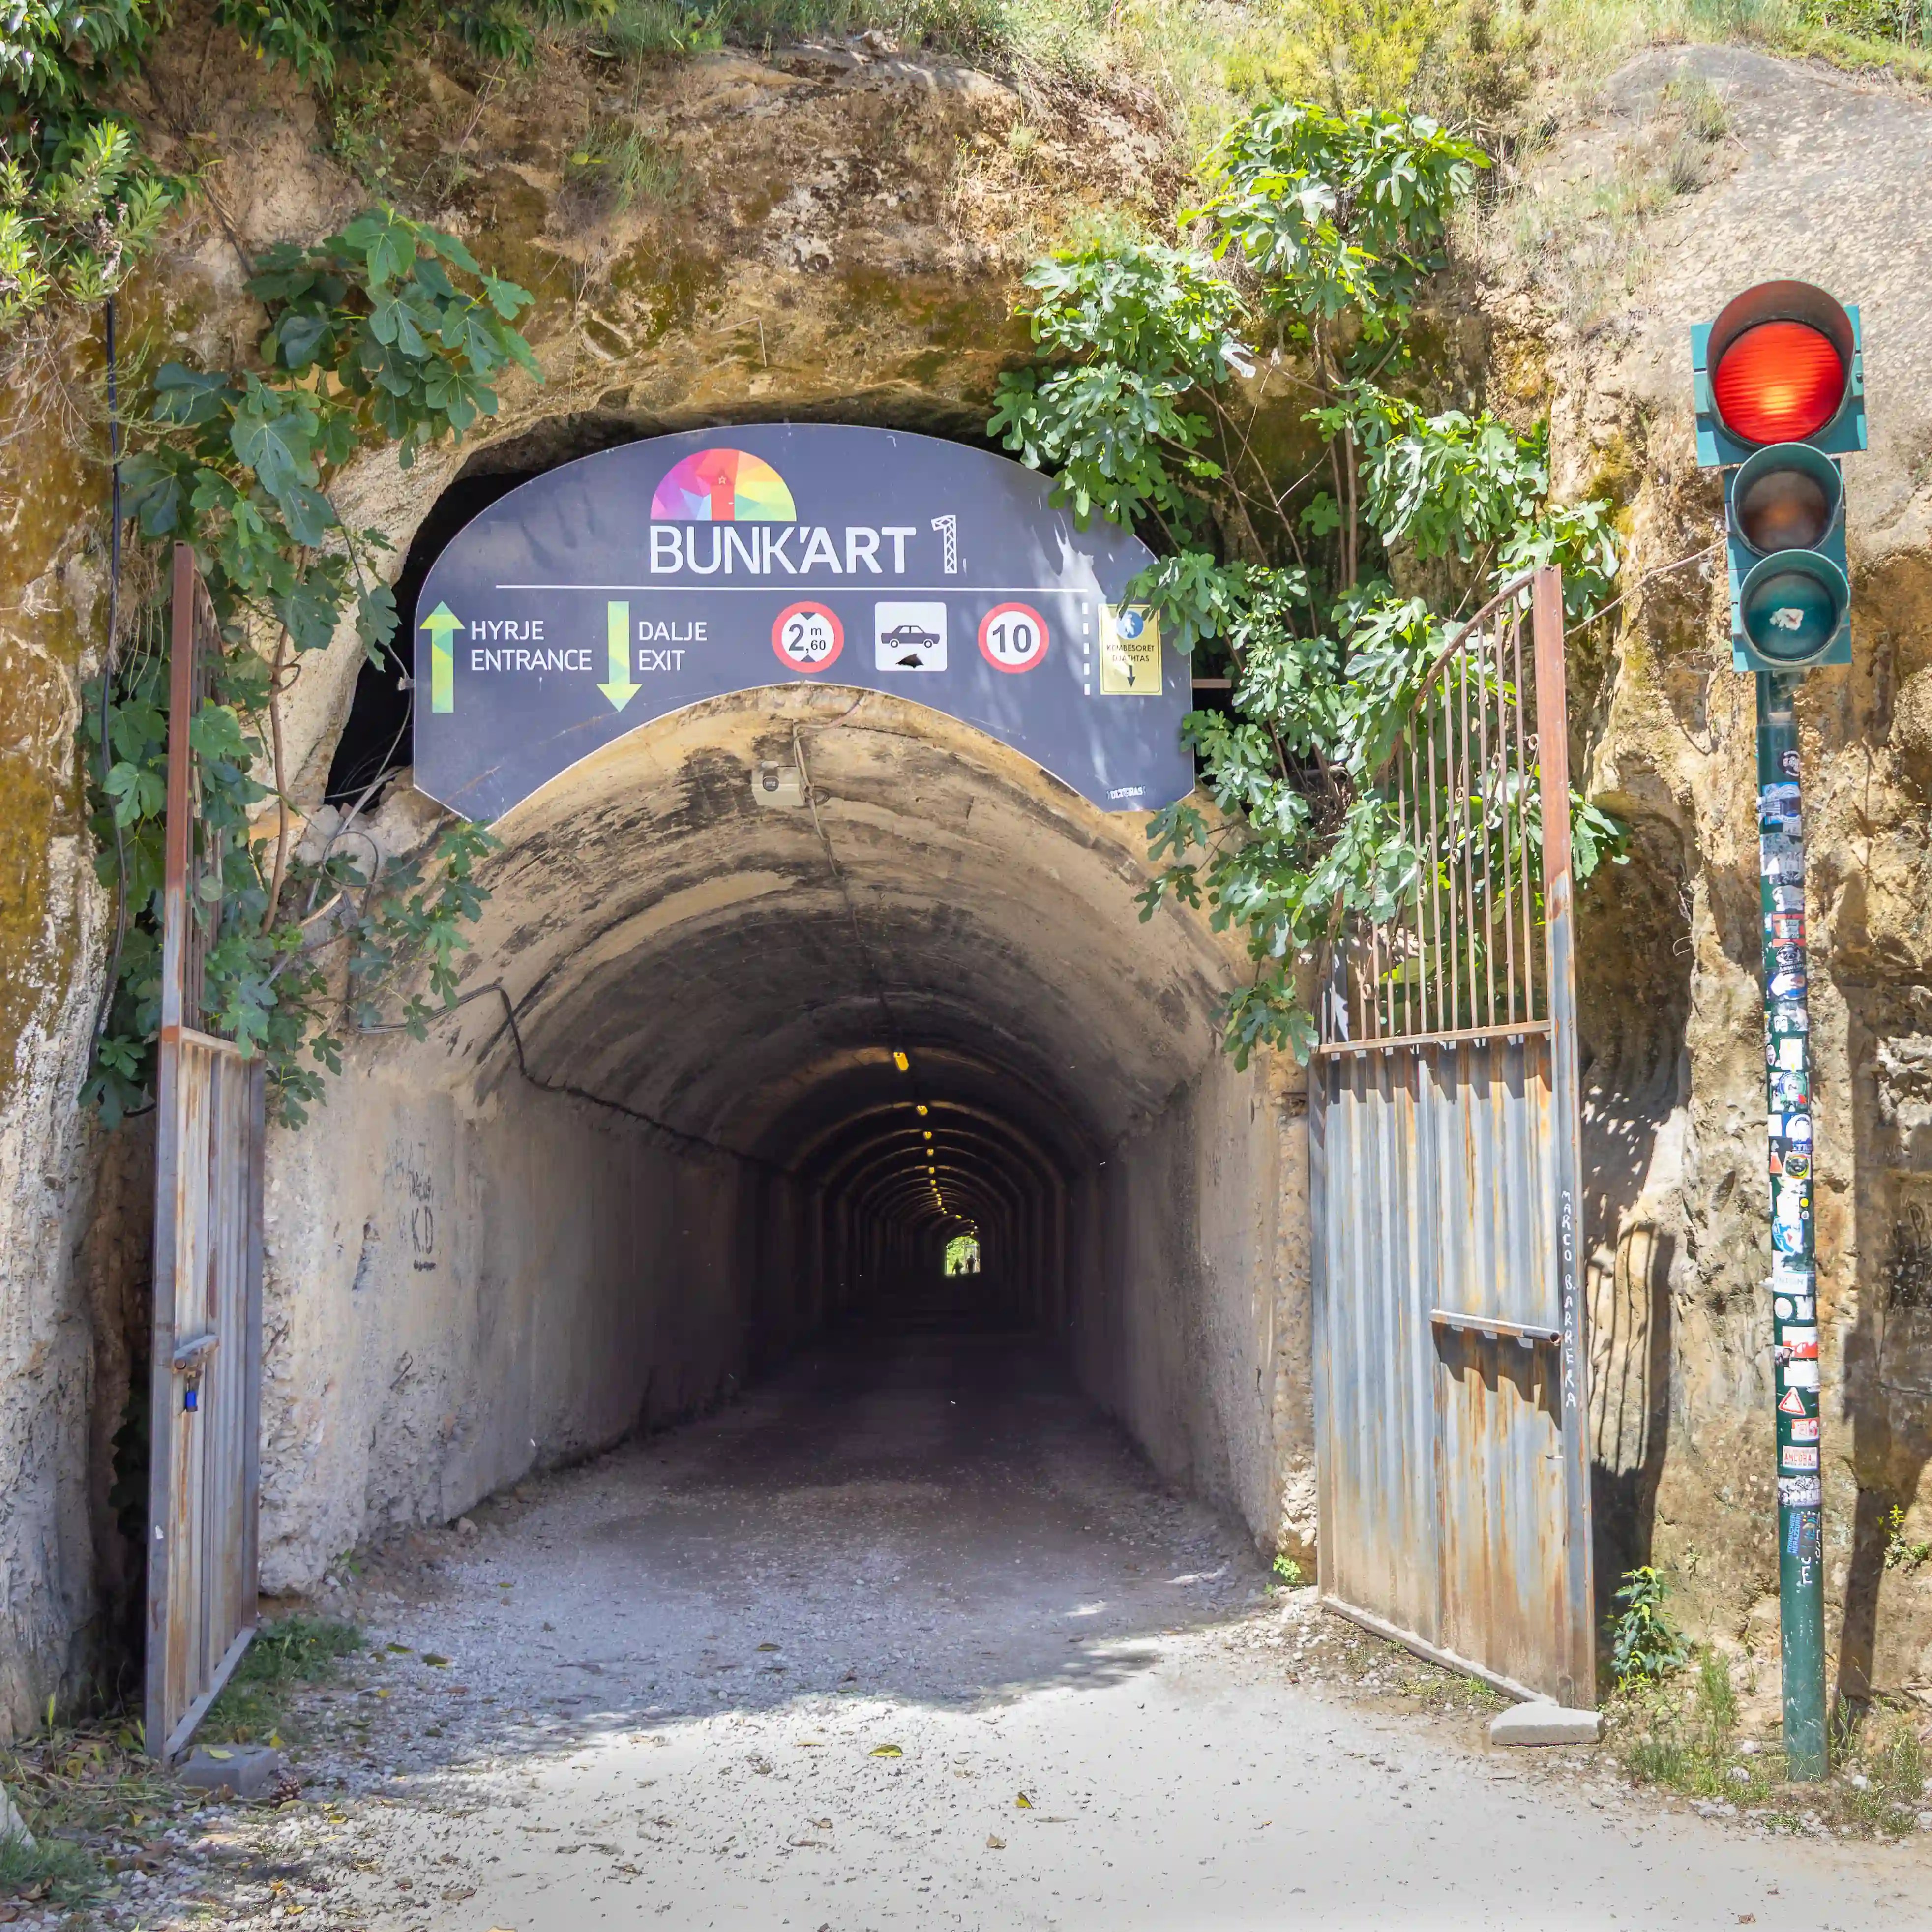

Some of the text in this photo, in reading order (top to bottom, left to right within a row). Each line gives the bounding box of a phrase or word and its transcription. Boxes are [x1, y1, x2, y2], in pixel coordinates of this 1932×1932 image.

[650, 514, 958, 574] BUNK'ART 1
[471, 620, 545, 640] HYRJE
[639, 621, 708, 641] DALJE
[992, 624, 1032, 654] 10
[471, 648, 593, 672] ENTRANCE
[639, 648, 686, 671] EXIT
[1561, 1189, 1577, 1408] MARCO BARRERA
